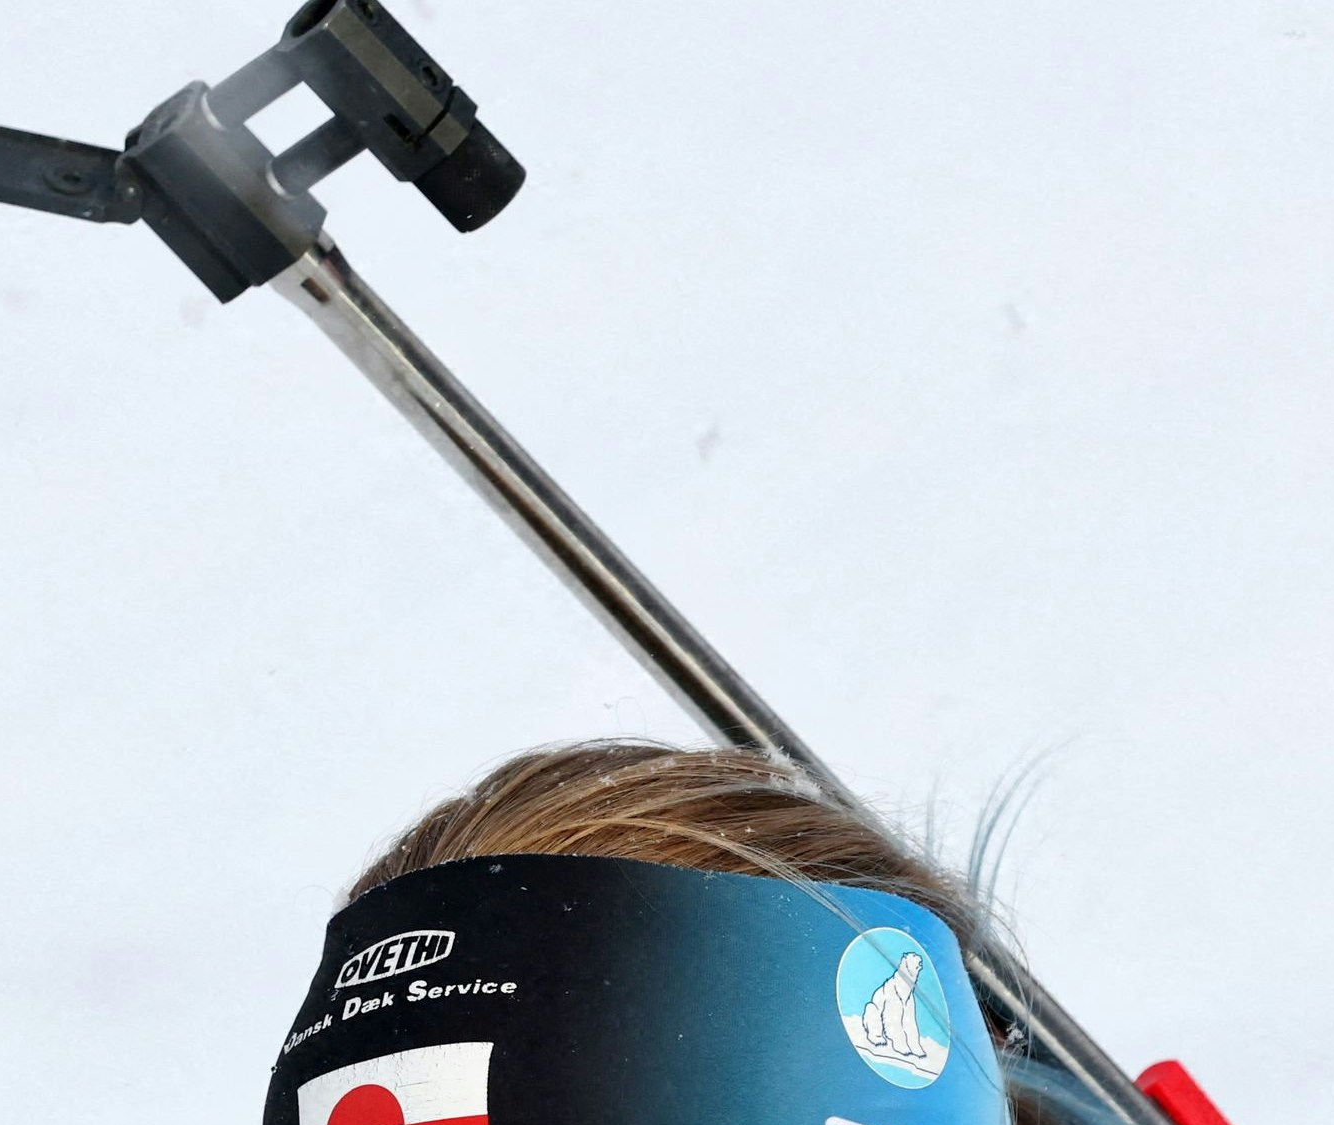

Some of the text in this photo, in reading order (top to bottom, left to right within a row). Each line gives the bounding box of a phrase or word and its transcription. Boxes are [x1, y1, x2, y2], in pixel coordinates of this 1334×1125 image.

[283, 979, 518, 1055] Dansk Dæk Service
